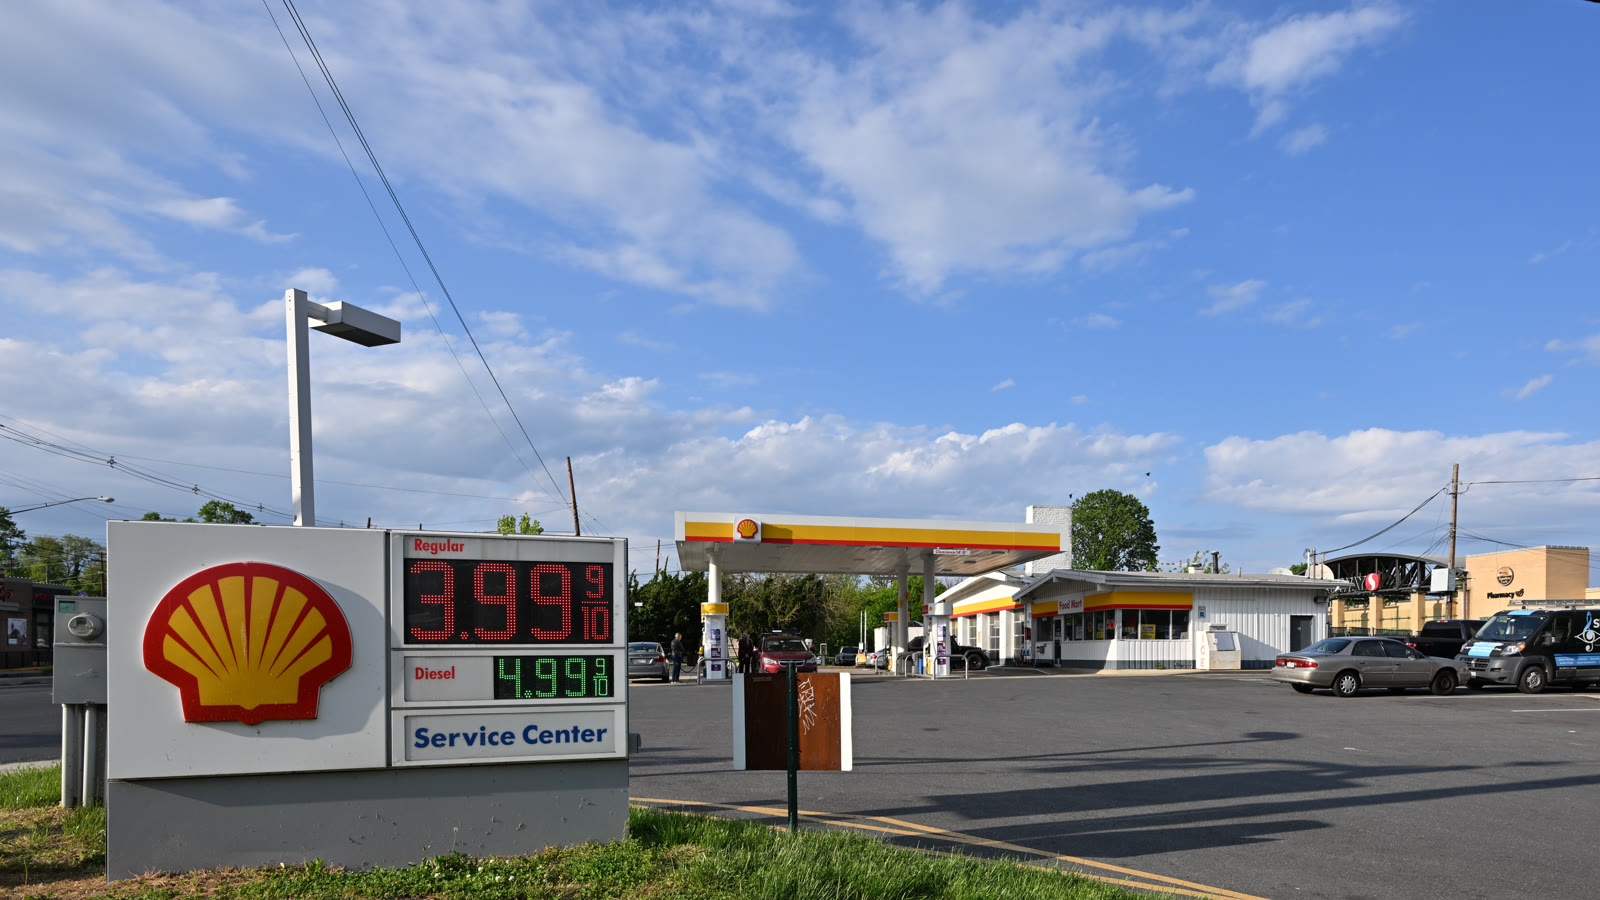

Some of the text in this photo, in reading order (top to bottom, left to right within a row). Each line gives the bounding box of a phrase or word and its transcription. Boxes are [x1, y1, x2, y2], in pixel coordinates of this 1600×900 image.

[414, 538, 465, 555] Regular
[410, 561, 572, 640] 3.99
[1059, 599, 1082, 610] Food Mart
[415, 666, 456, 680] Diesel
[499, 658, 586, 698] 4.99
[414, 724, 607, 748] Service Center
